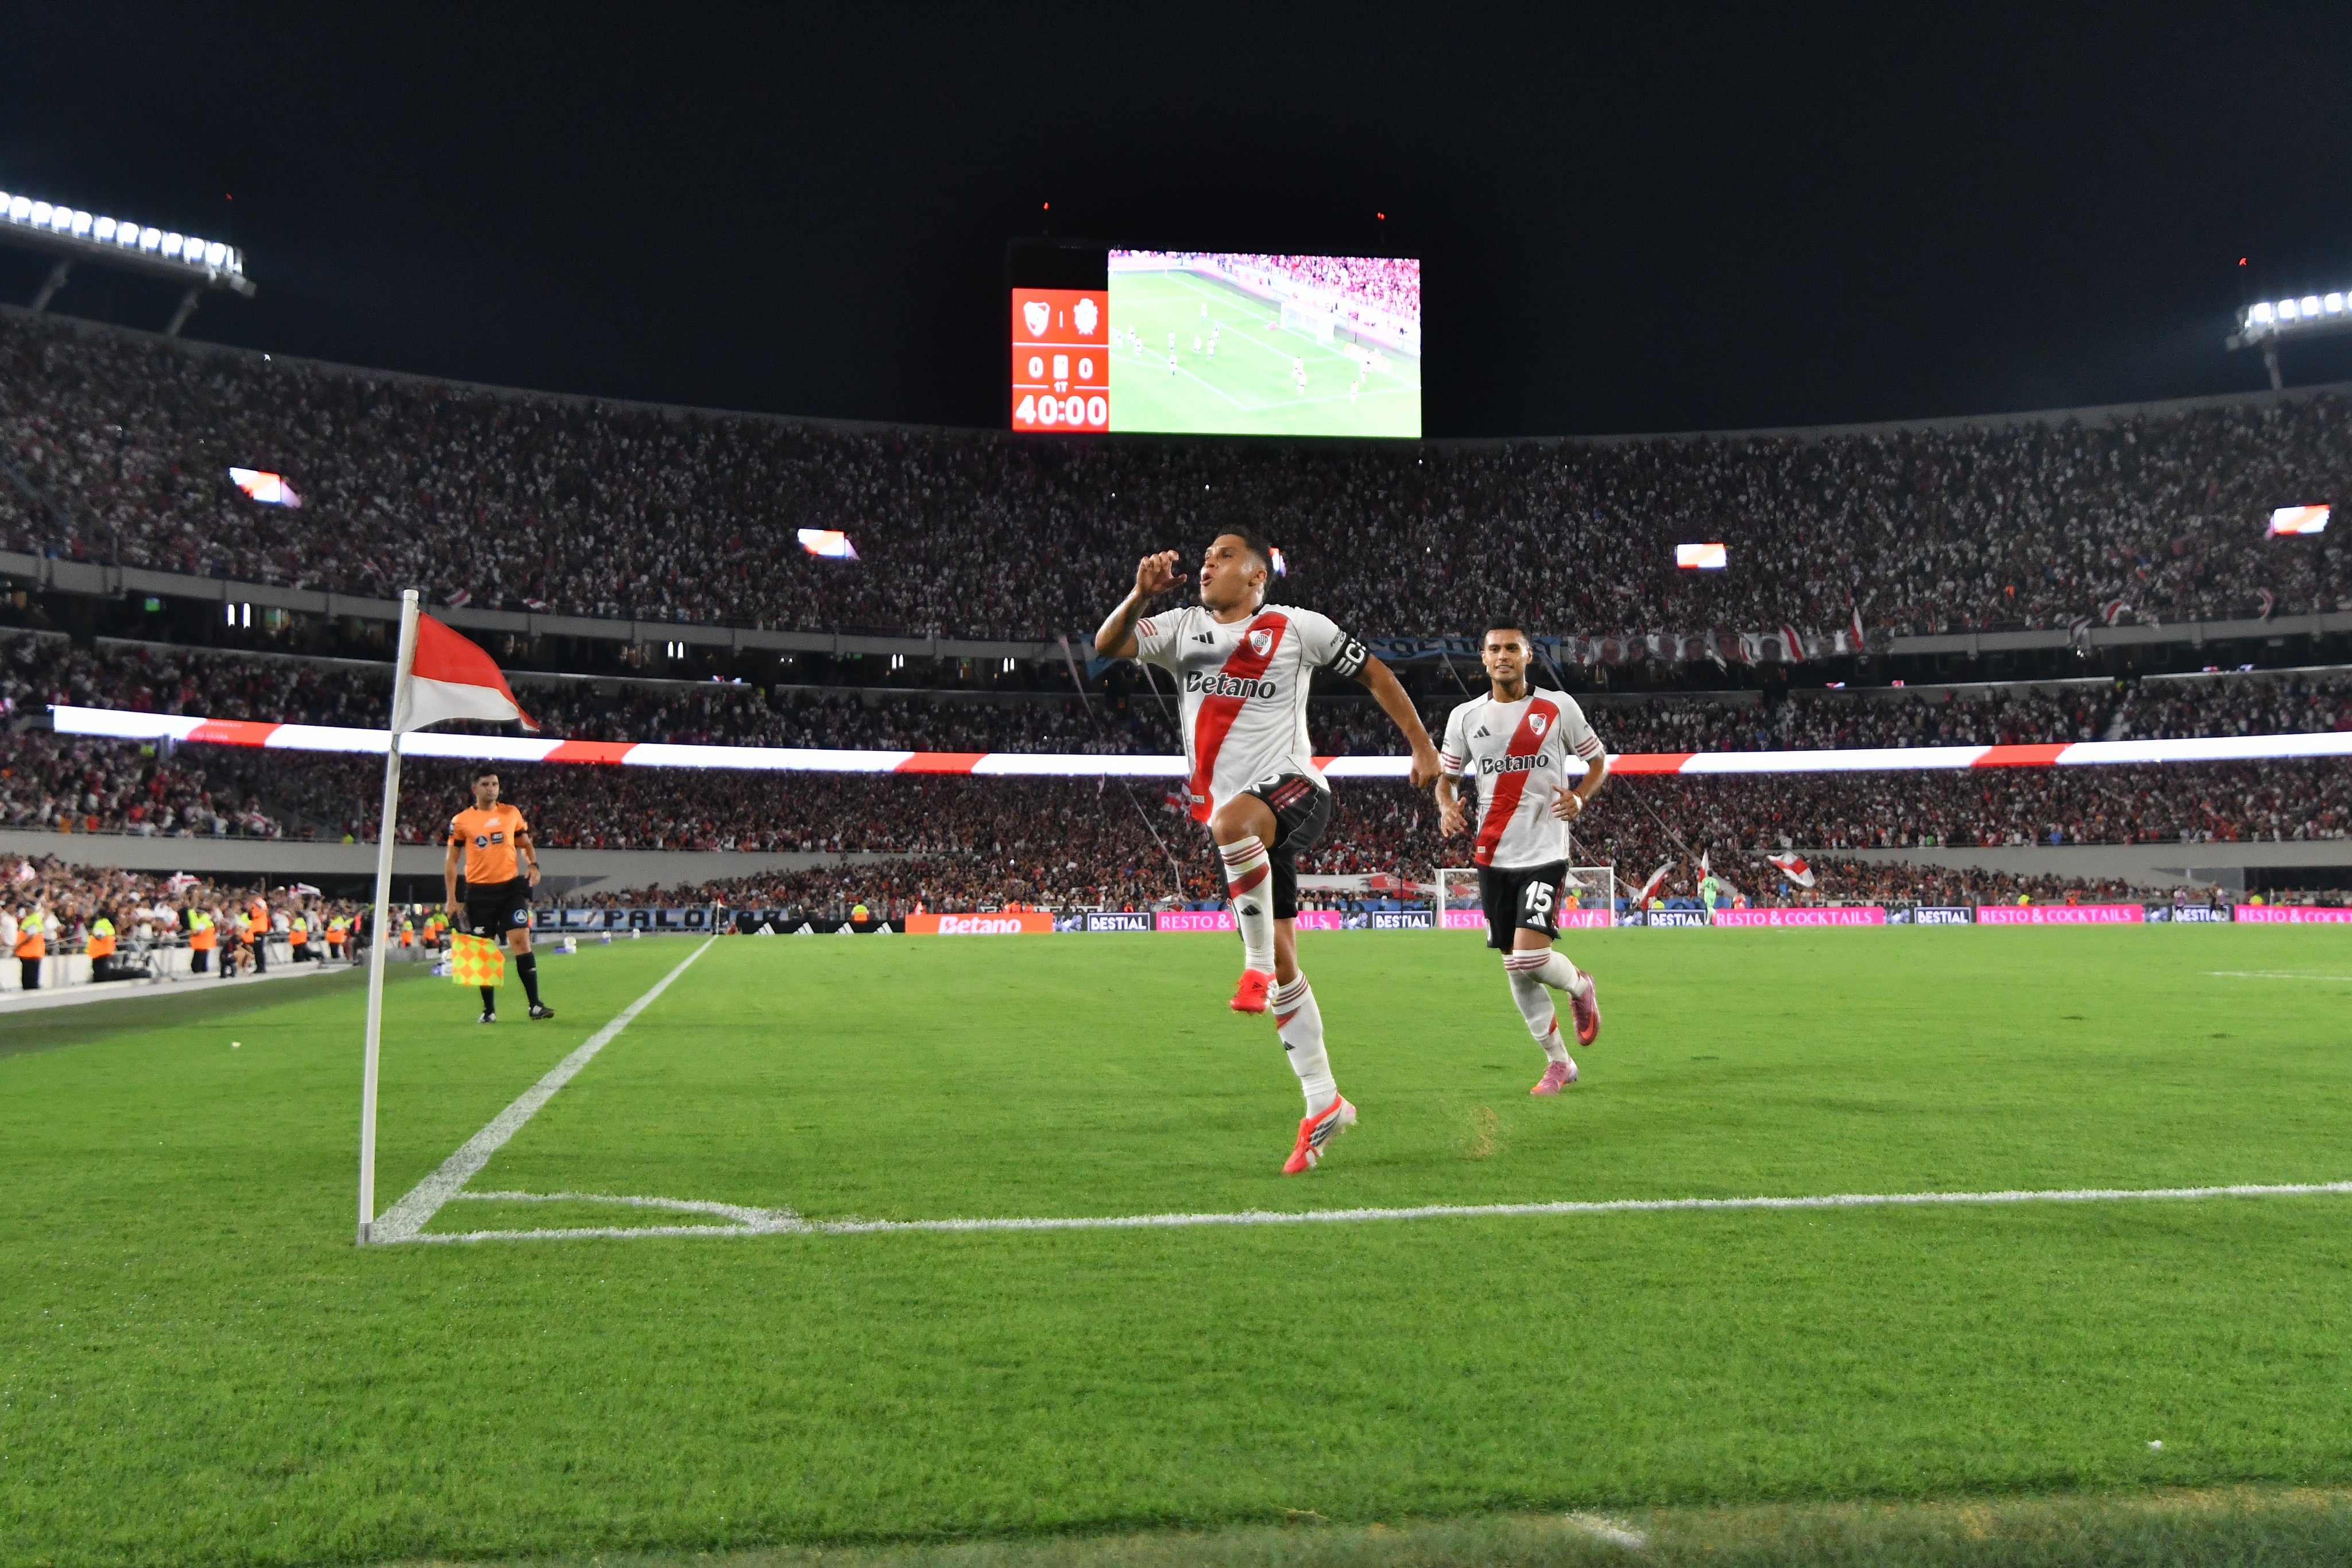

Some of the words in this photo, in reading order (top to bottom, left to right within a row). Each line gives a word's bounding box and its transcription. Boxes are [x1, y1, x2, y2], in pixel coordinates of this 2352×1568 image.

[1028, 357, 1043, 378] 0
[1078, 358, 1093, 379] 0
[1054, 381, 1068, 392] 1T
[1015, 395, 1107, 425] 40:00
[1186, 670, 1276, 699] Betano
[1481, 754, 1549, 775] Betano
[1526, 881, 1554, 912] 15
[537, 910, 579, 927] EL
[1091, 917, 1146, 930] BESTIAL
[1161, 916, 1213, 928] RESTO
[1217, 914, 1230, 929] &
[1376, 915, 1429, 928] BESTIAL
[1717, 913, 1766, 925] RESTO
[1770, 911, 1782, 925] &
[1785, 911, 1872, 924] COCKTAILS
[1918, 911, 1968, 923] BESTIAL
[1981, 910, 2028, 923] RESTO
[2032, 908, 2044, 923] &
[2047, 909, 2131, 922] COCKTAILS
[2239, 909, 2286, 922] RESTO
[2289, 908, 2301, 923] &
[938, 916, 1022, 934] Betano
